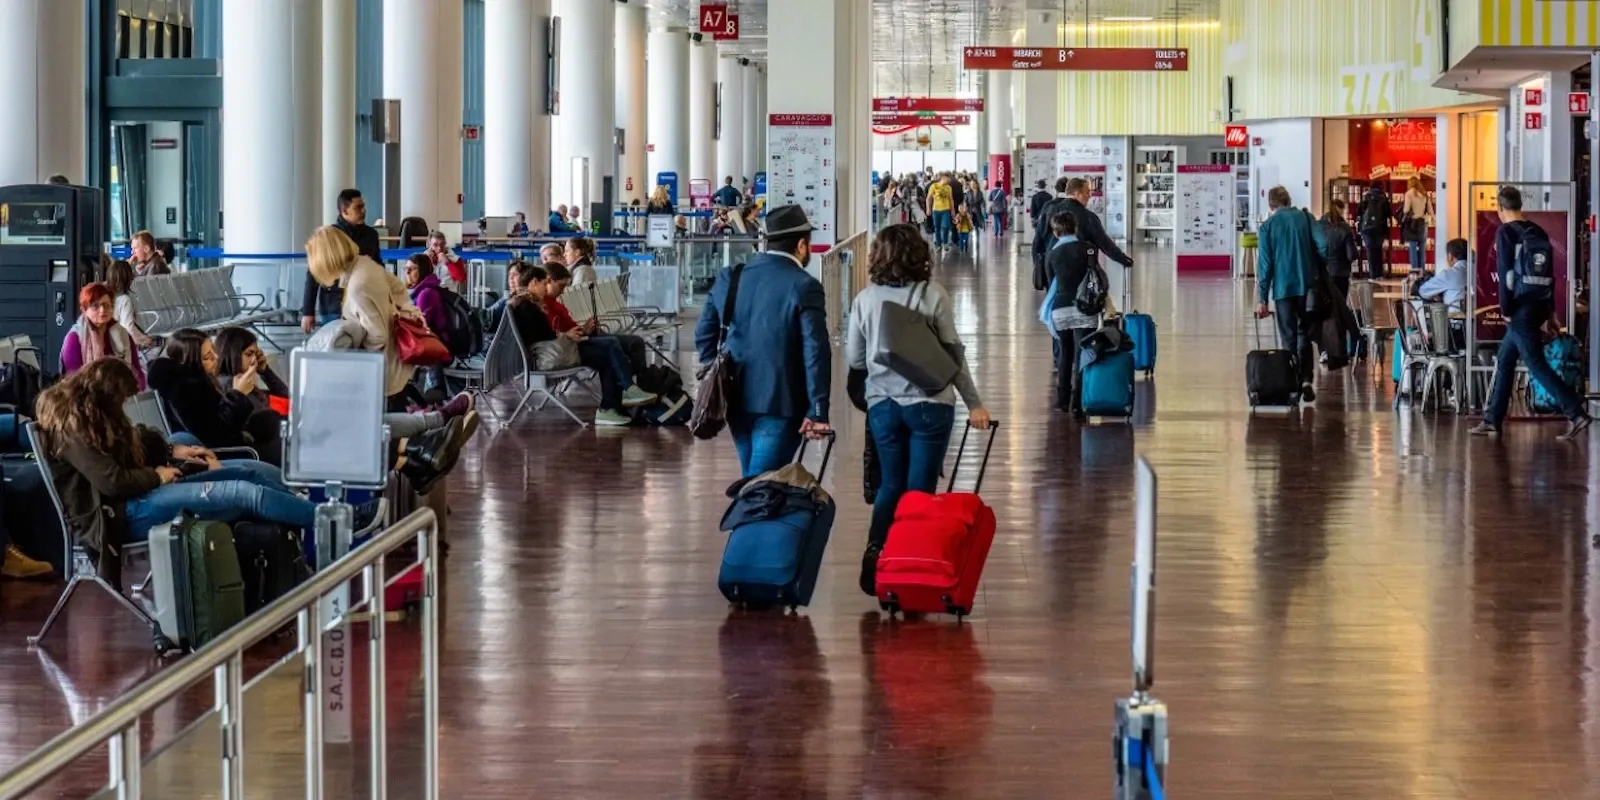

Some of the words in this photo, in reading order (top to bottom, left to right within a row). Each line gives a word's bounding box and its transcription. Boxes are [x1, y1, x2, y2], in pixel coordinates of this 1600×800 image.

[703, 10, 723, 27] A7
[1059, 49, 1067, 63] B
[1155, 50, 1178, 59] TOILETS
[1227, 128, 1246, 145] illy
